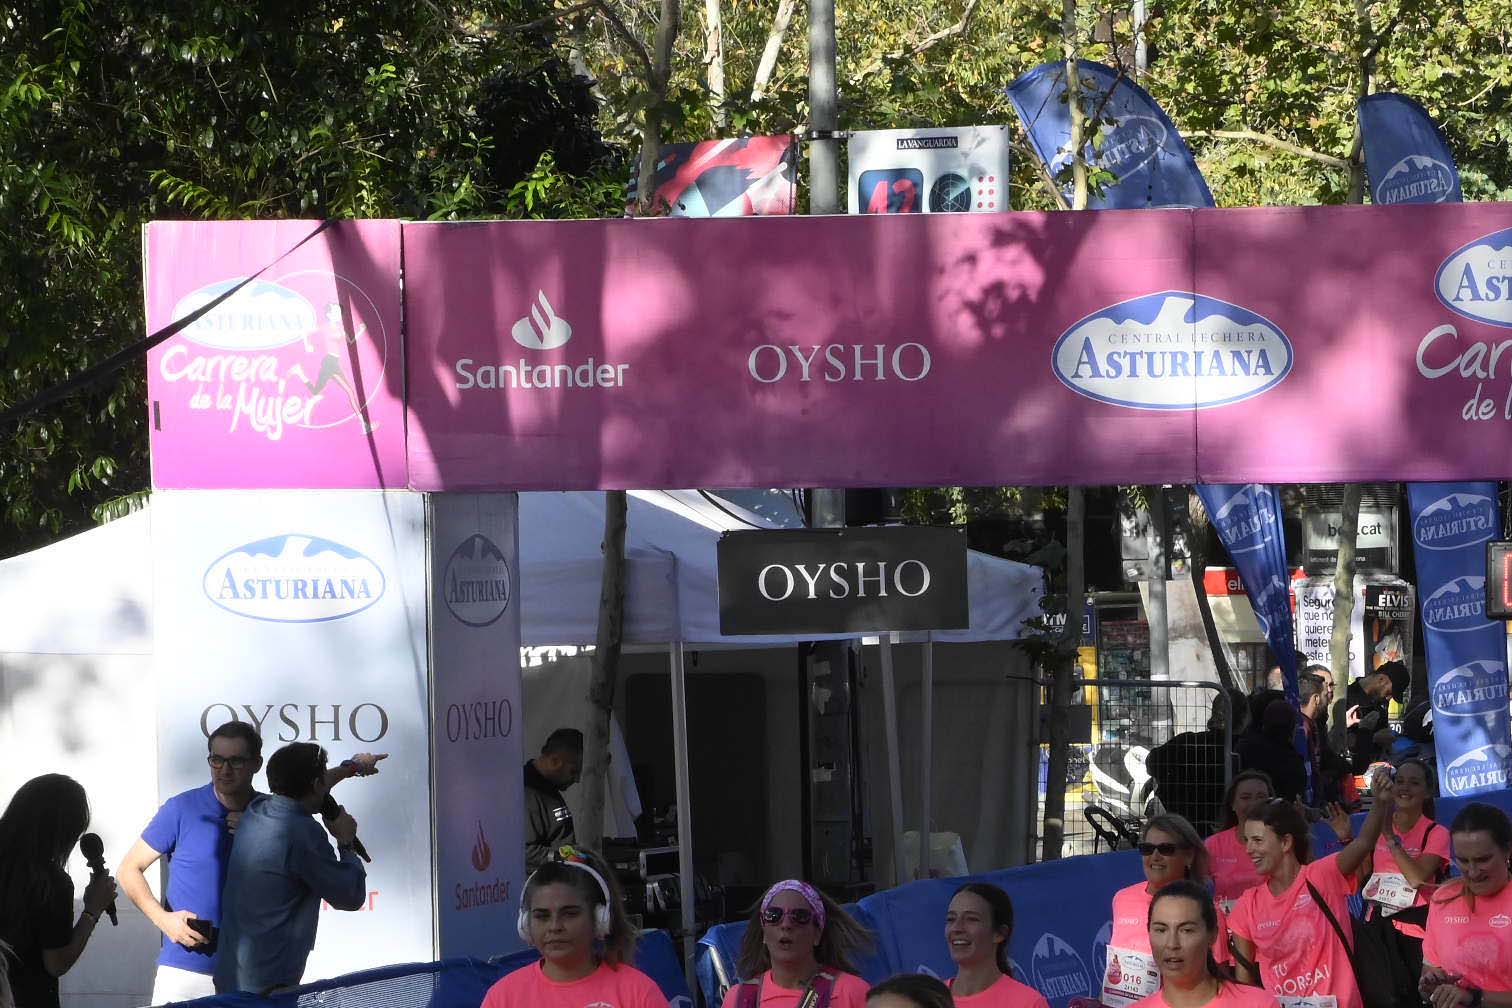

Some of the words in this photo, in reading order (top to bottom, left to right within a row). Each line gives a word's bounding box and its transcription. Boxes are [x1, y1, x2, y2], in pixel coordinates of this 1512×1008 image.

[909, 137, 957, 149] VANGUARDIA
[1108, 333, 1182, 345] CENTRAL
[1191, 331, 1267, 343] LECHERA
[160, 345, 283, 382] Carrera
[456, 358, 629, 389] Santander
[748, 342, 932, 383] OYSHO
[1071, 336, 1275, 379] ASTURIANA
[190, 382, 211, 409] de
[216, 380, 232, 410] la
[229, 379, 324, 440] Mujer
[1462, 383, 1496, 420] de
[217, 567, 372, 600] ASTURIANA
[758, 560, 930, 600] OYSHO
[1379, 595, 1409, 607] ELVIS
[446, 698, 512, 743] OYSHO
[455, 879, 511, 911] Santander
[1123, 972, 1142, 985] 016
